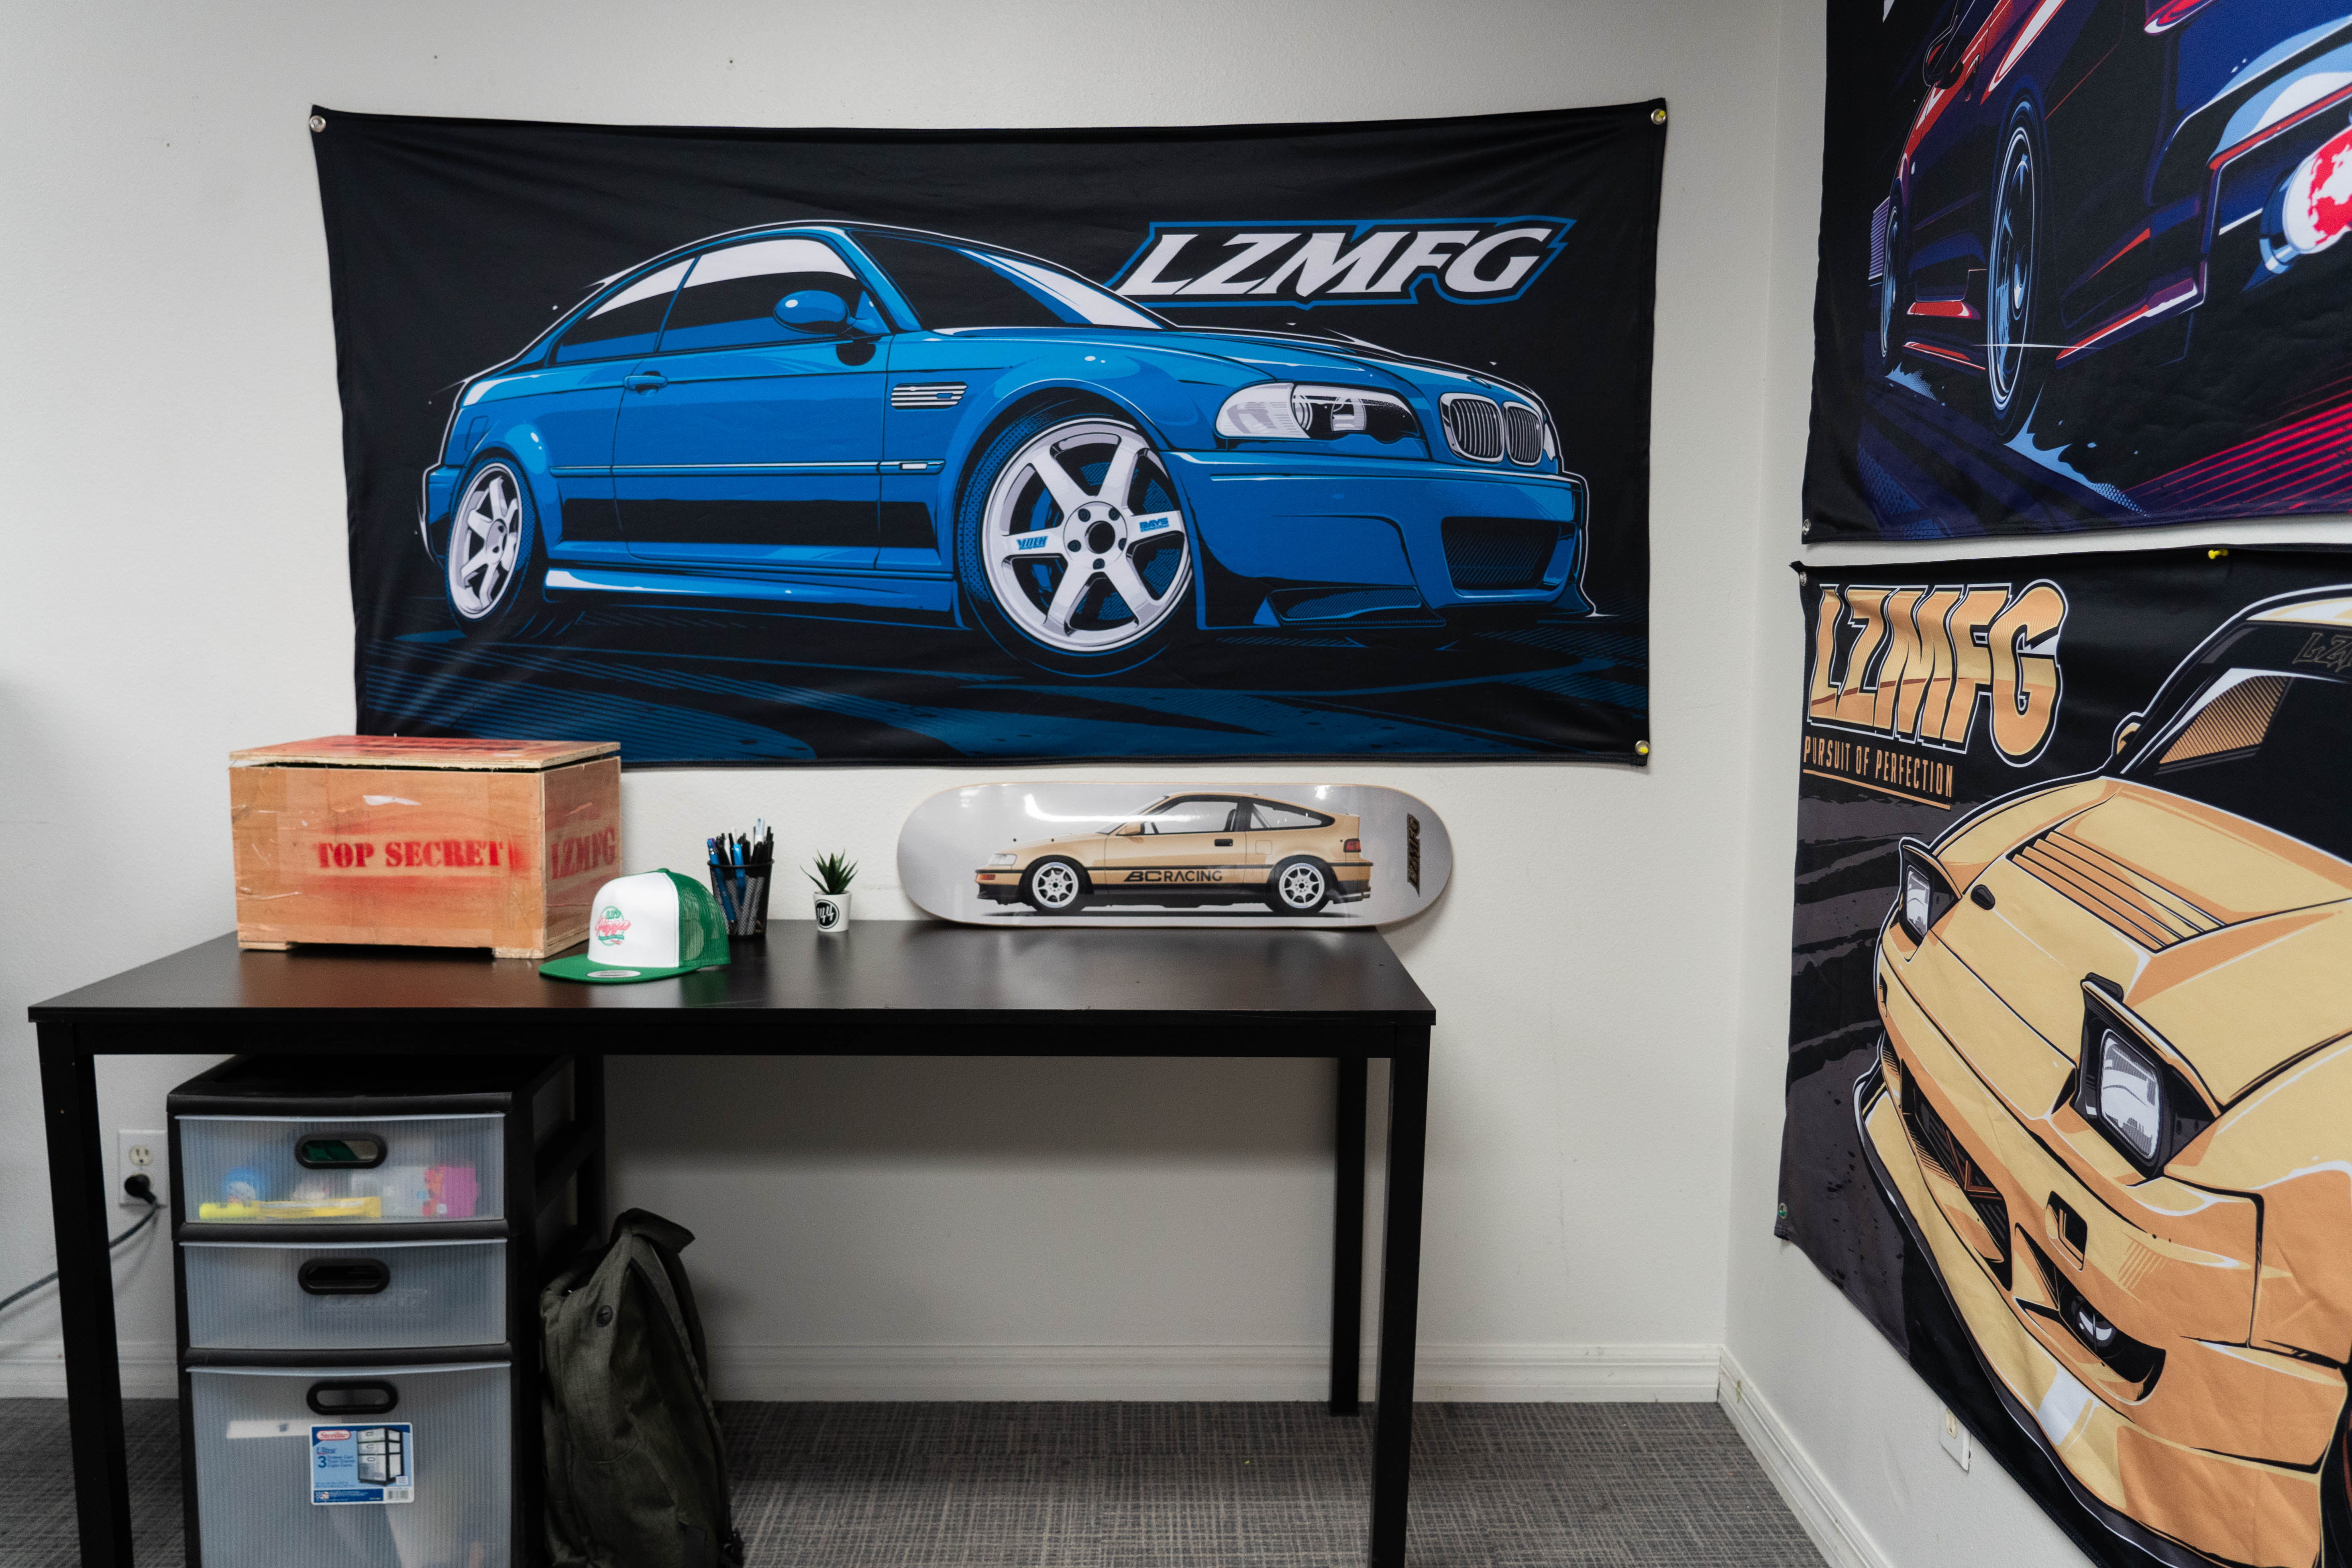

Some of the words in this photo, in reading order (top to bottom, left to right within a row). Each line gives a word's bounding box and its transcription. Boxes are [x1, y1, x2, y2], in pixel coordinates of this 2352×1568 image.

[1115, 228, 1553, 297] LZMFG
[1809, 584, 2066, 758] LZMFG
[1803, 736, 1851, 771] PURSUIT
[1856, 746, 1870, 776] OF
[1875, 749, 1953, 798] PERFECTION
[318, 842, 375, 869] TOP
[385, 840, 503, 867] SECRET
[551, 826, 616, 879] LZMFG
[318, 1456, 327, 1468] 3
